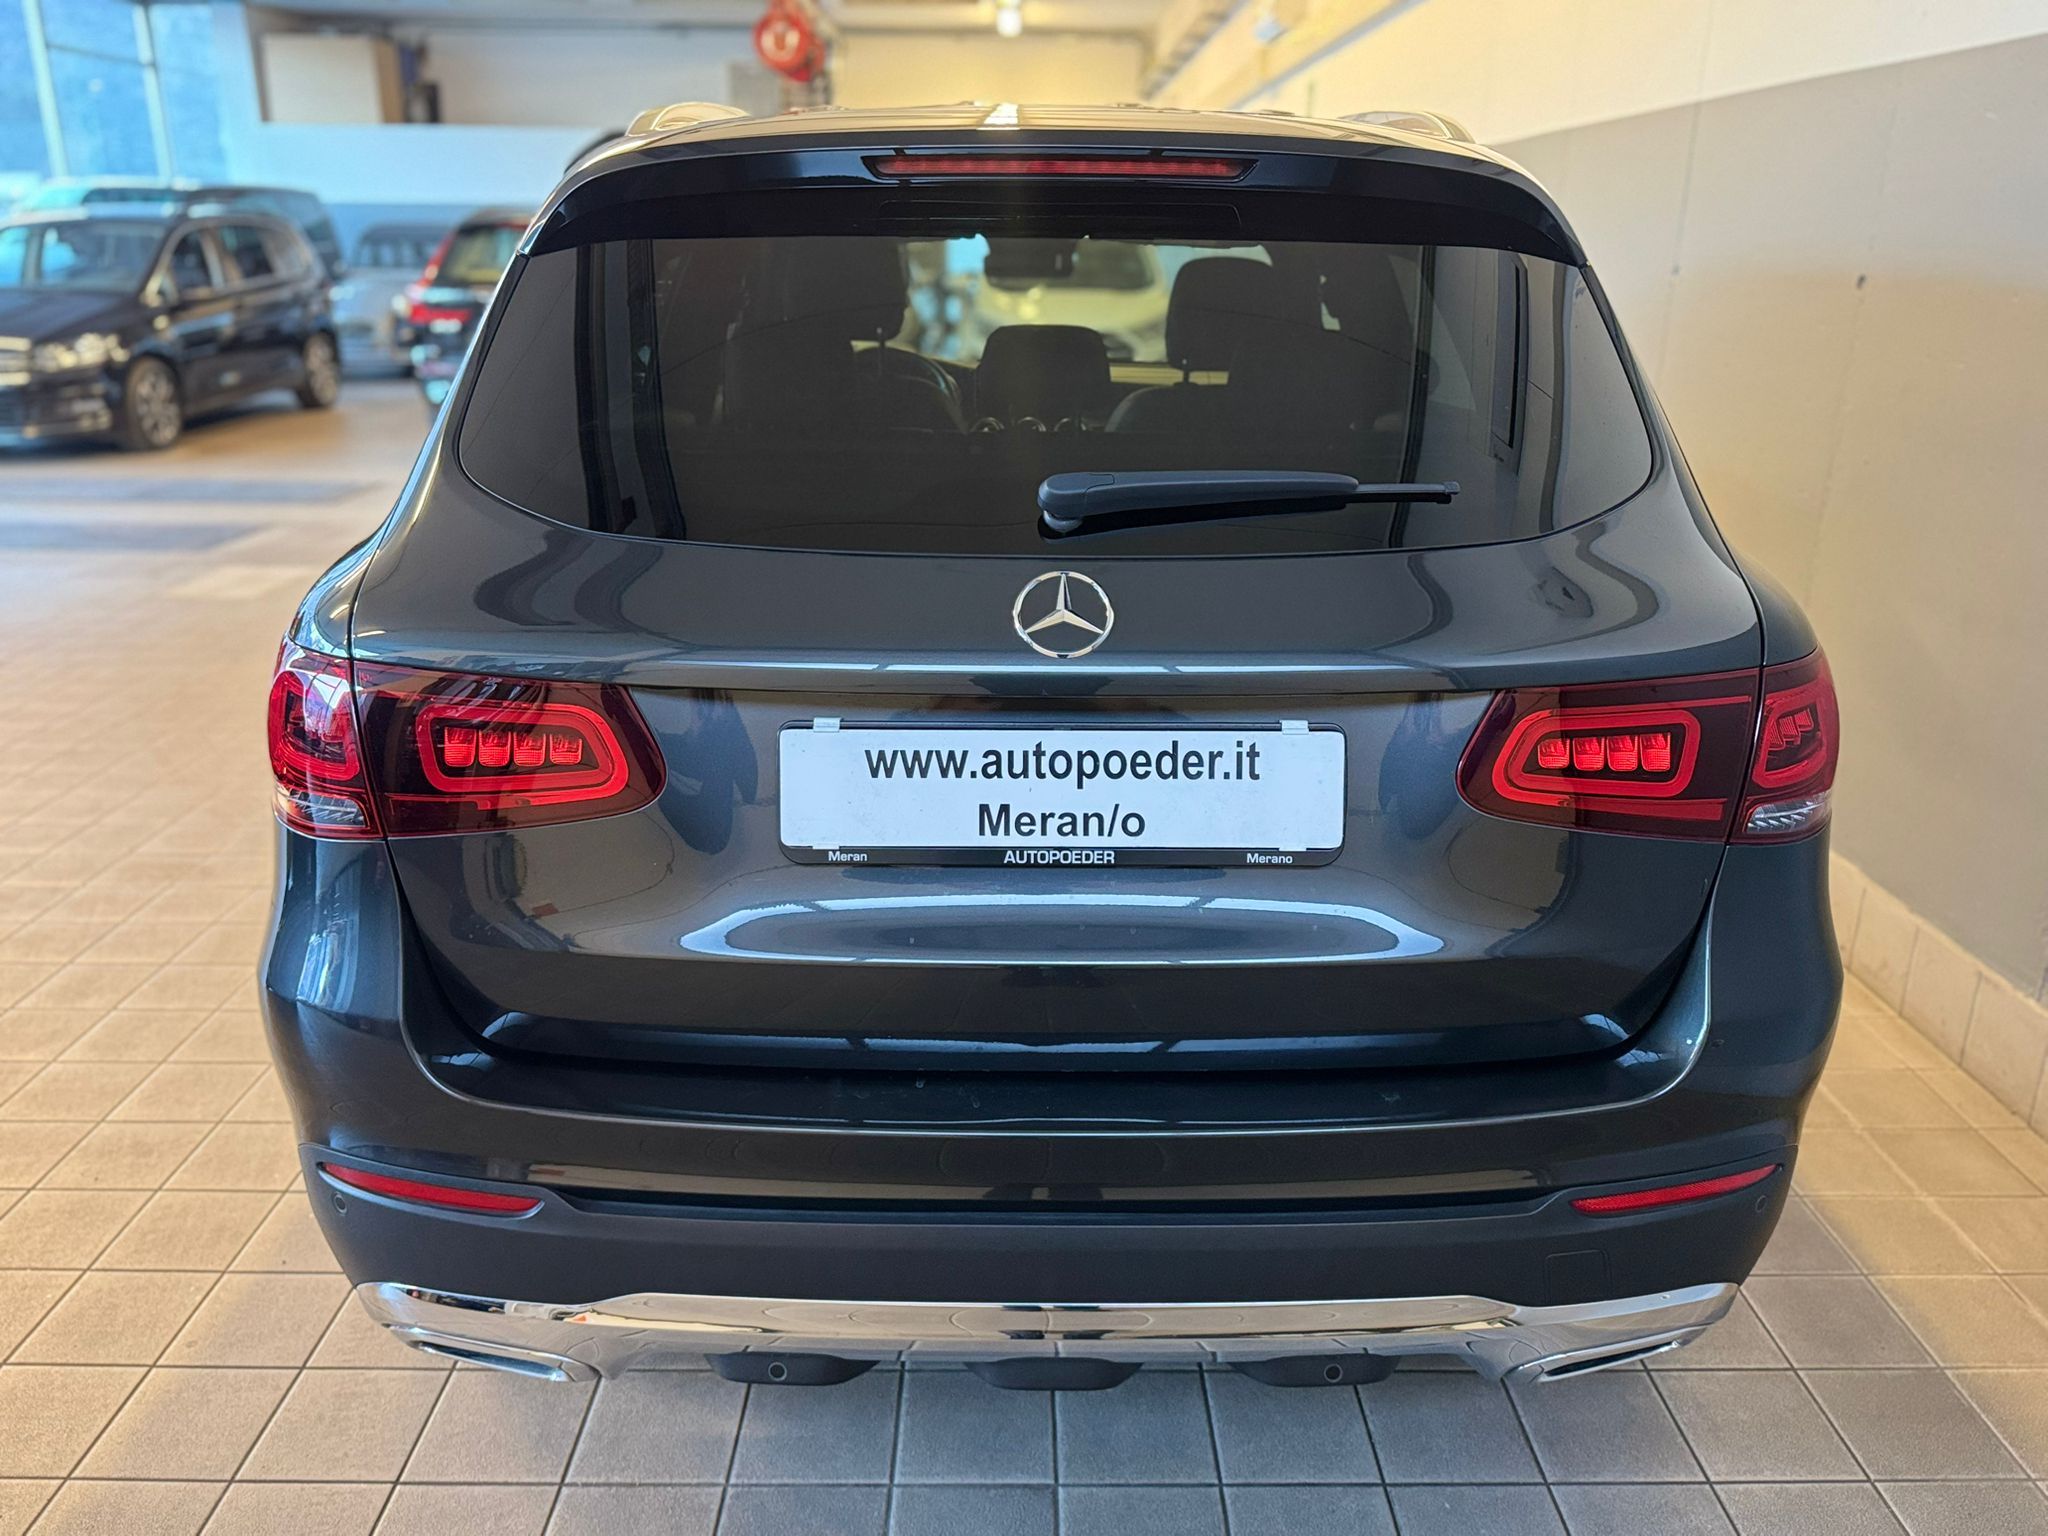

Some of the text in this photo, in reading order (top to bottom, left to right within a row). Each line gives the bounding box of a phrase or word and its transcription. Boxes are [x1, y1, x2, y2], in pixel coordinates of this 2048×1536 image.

[865, 740, 1260, 789] www.autopoeder.it
[978, 803, 1146, 837] Meran/o
[828, 850, 1293, 864] Meran AUTOPOEDER Merano
